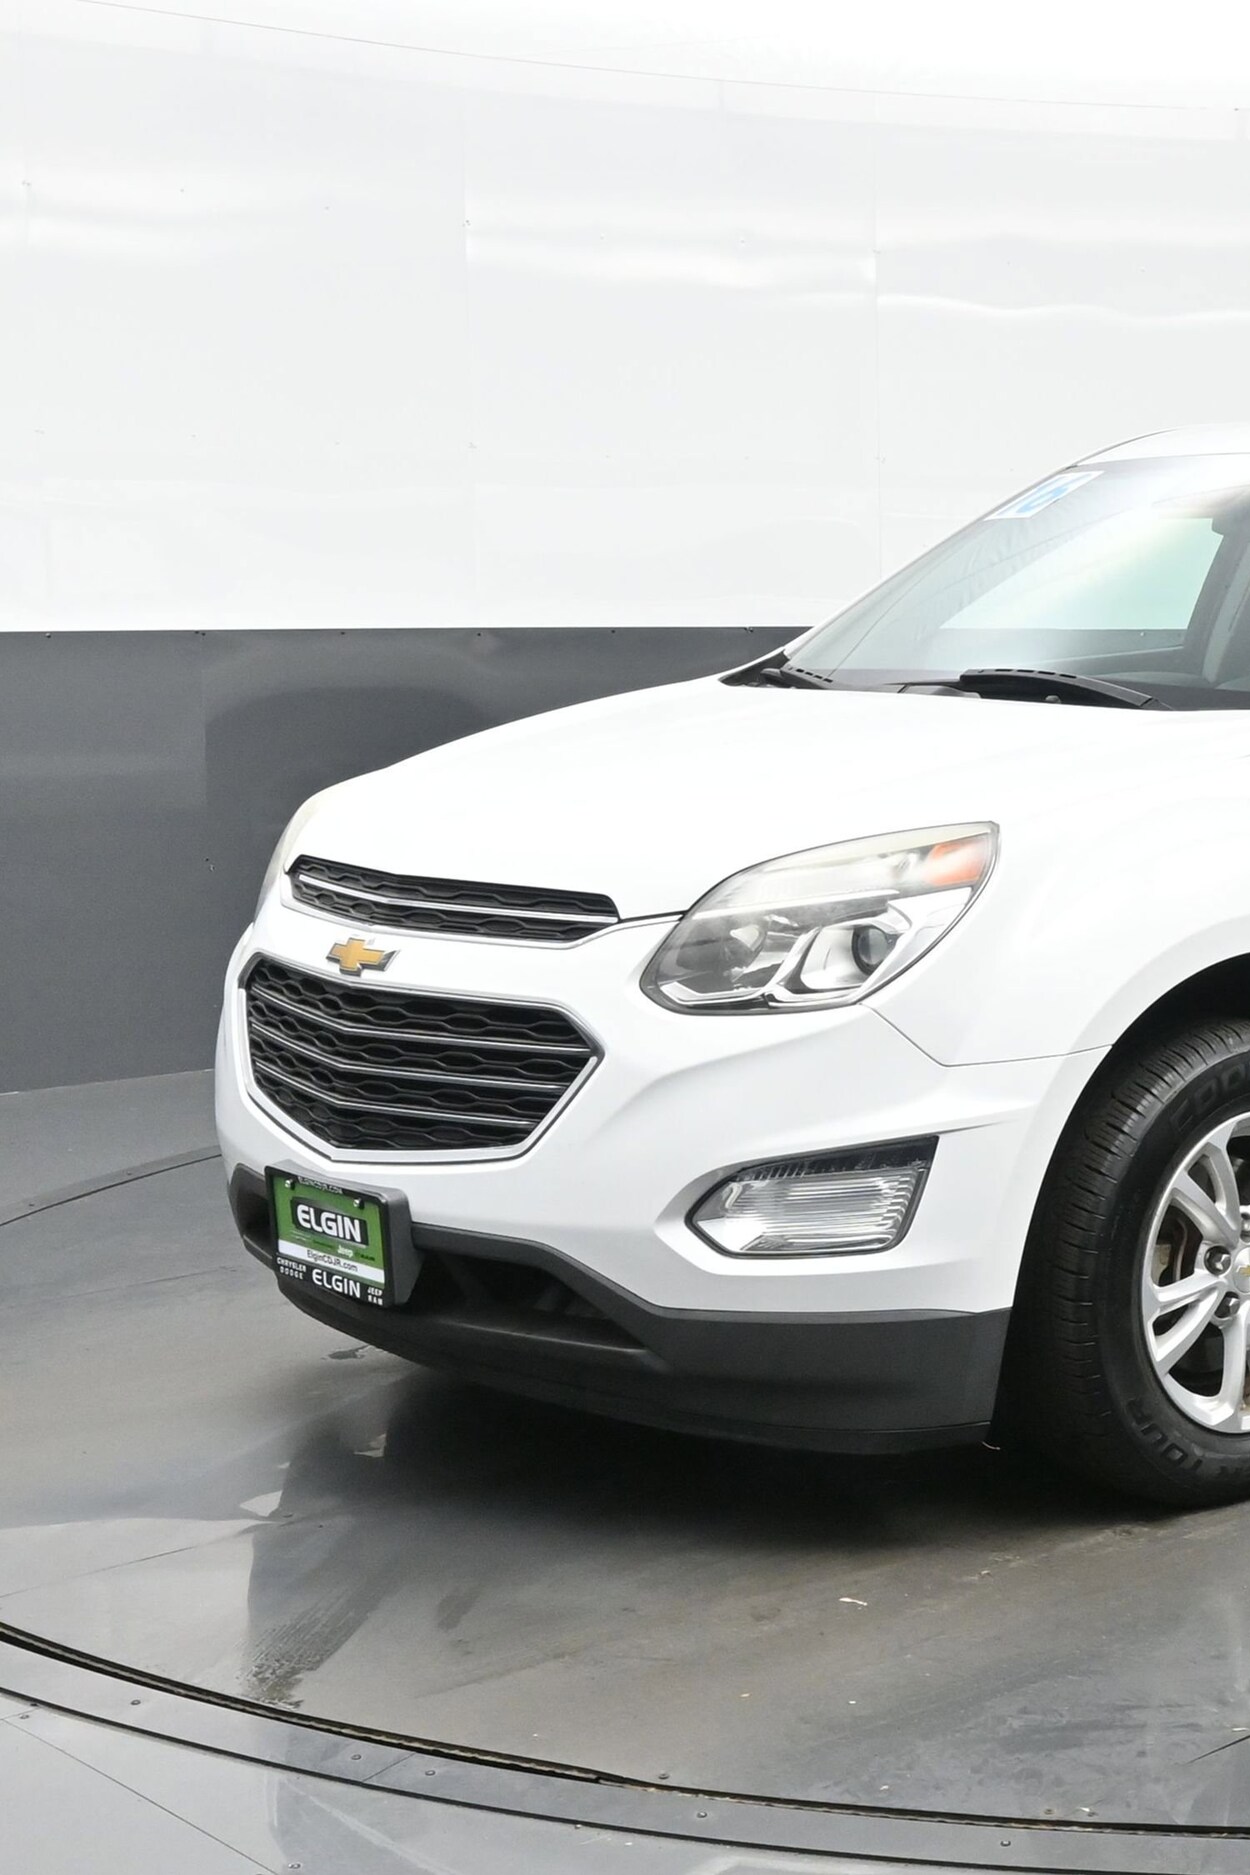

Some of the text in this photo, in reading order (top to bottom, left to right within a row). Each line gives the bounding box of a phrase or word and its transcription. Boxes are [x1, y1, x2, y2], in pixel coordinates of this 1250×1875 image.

[296, 1203, 362, 1243] ELGIN
[276, 1257, 307, 1272] CHRYSLER
[306, 1249, 359, 1273] ElginCDJR.com
[280, 1266, 304, 1280] DODGE
[311, 1269, 361, 1298] ELGIN
[367, 1286, 383, 1297] JEEP
[367, 1295, 383, 1306] RAM
